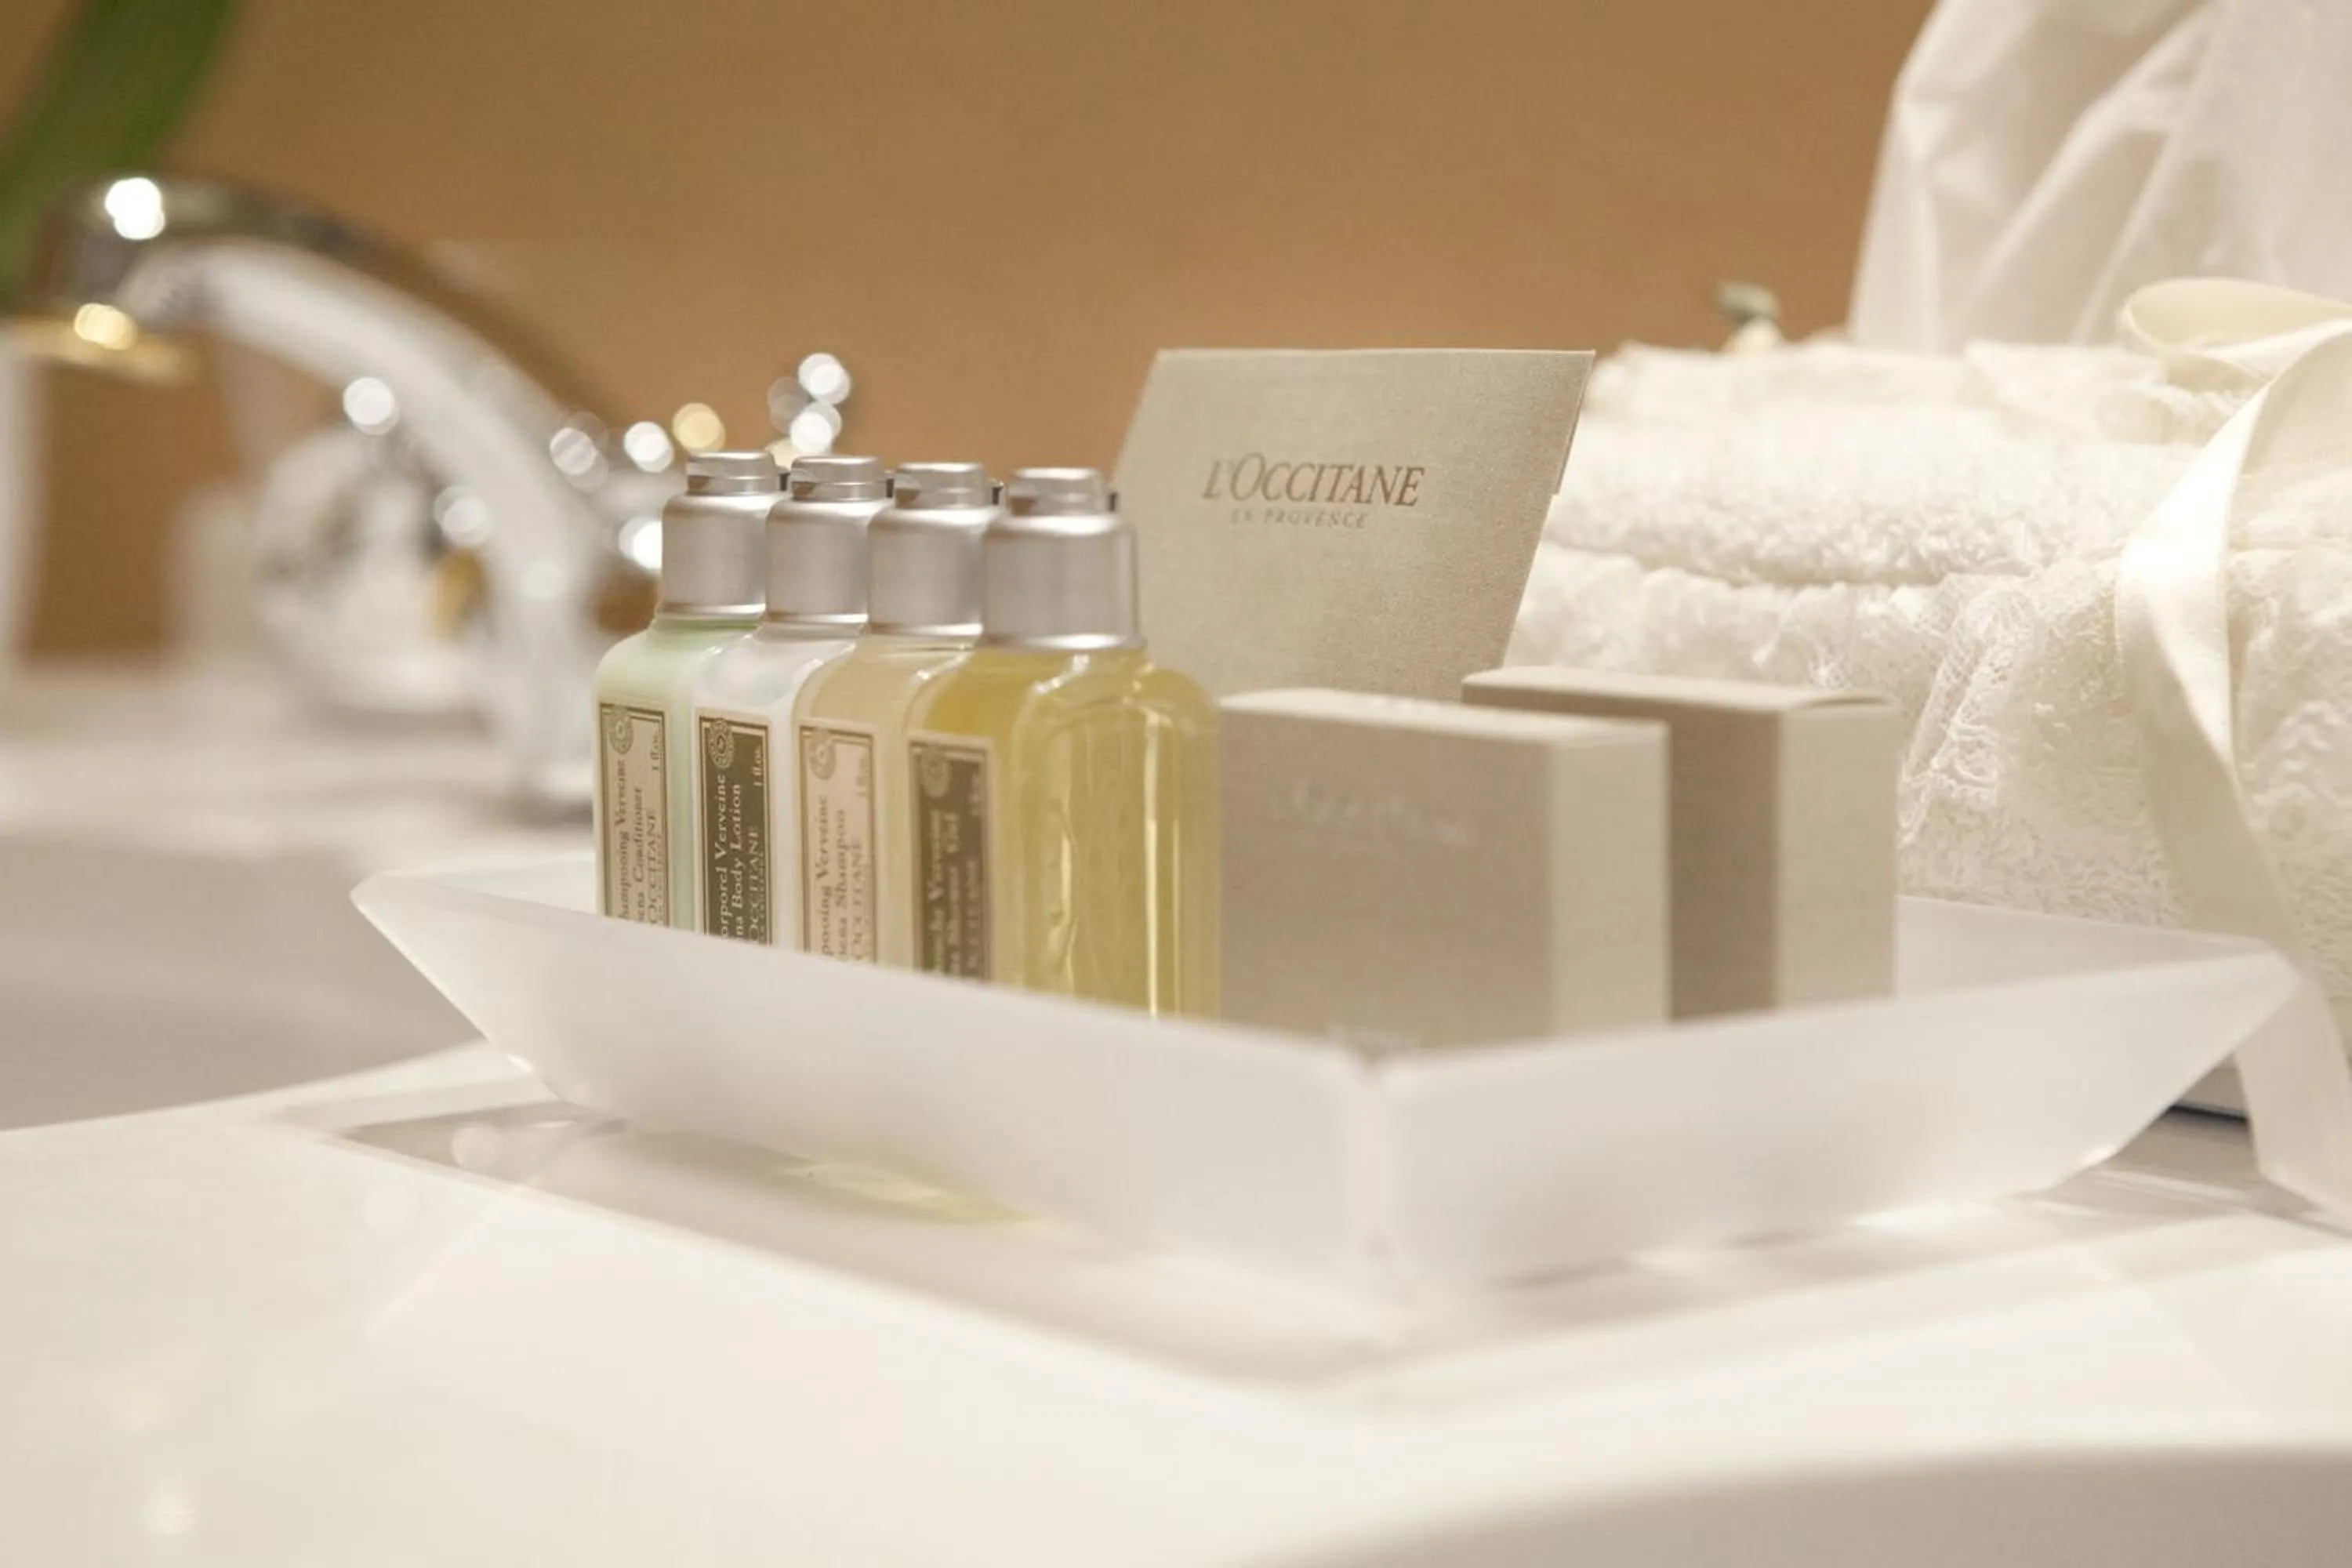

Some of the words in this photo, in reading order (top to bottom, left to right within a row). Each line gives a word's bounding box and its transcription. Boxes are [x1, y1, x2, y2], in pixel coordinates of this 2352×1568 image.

[1203, 452, 1425, 506] L'OCCITANE
[1263, 509, 1371, 529] PROVENCE
[633, 786, 645, 883] Conditioner
[714, 774, 728, 859] Verveine
[730, 785, 742, 851] Lotion
[617, 831, 632, 920] hampooing
[646, 811, 658, 924] OCCITANE
[731, 858, 746, 909] Body
[749, 826, 760, 942] OCCITANE
[834, 809, 849, 909] Shampoo
[715, 866, 733, 940] orporel
[735, 916, 745, 940] na
[818, 886, 833, 956] pooing
